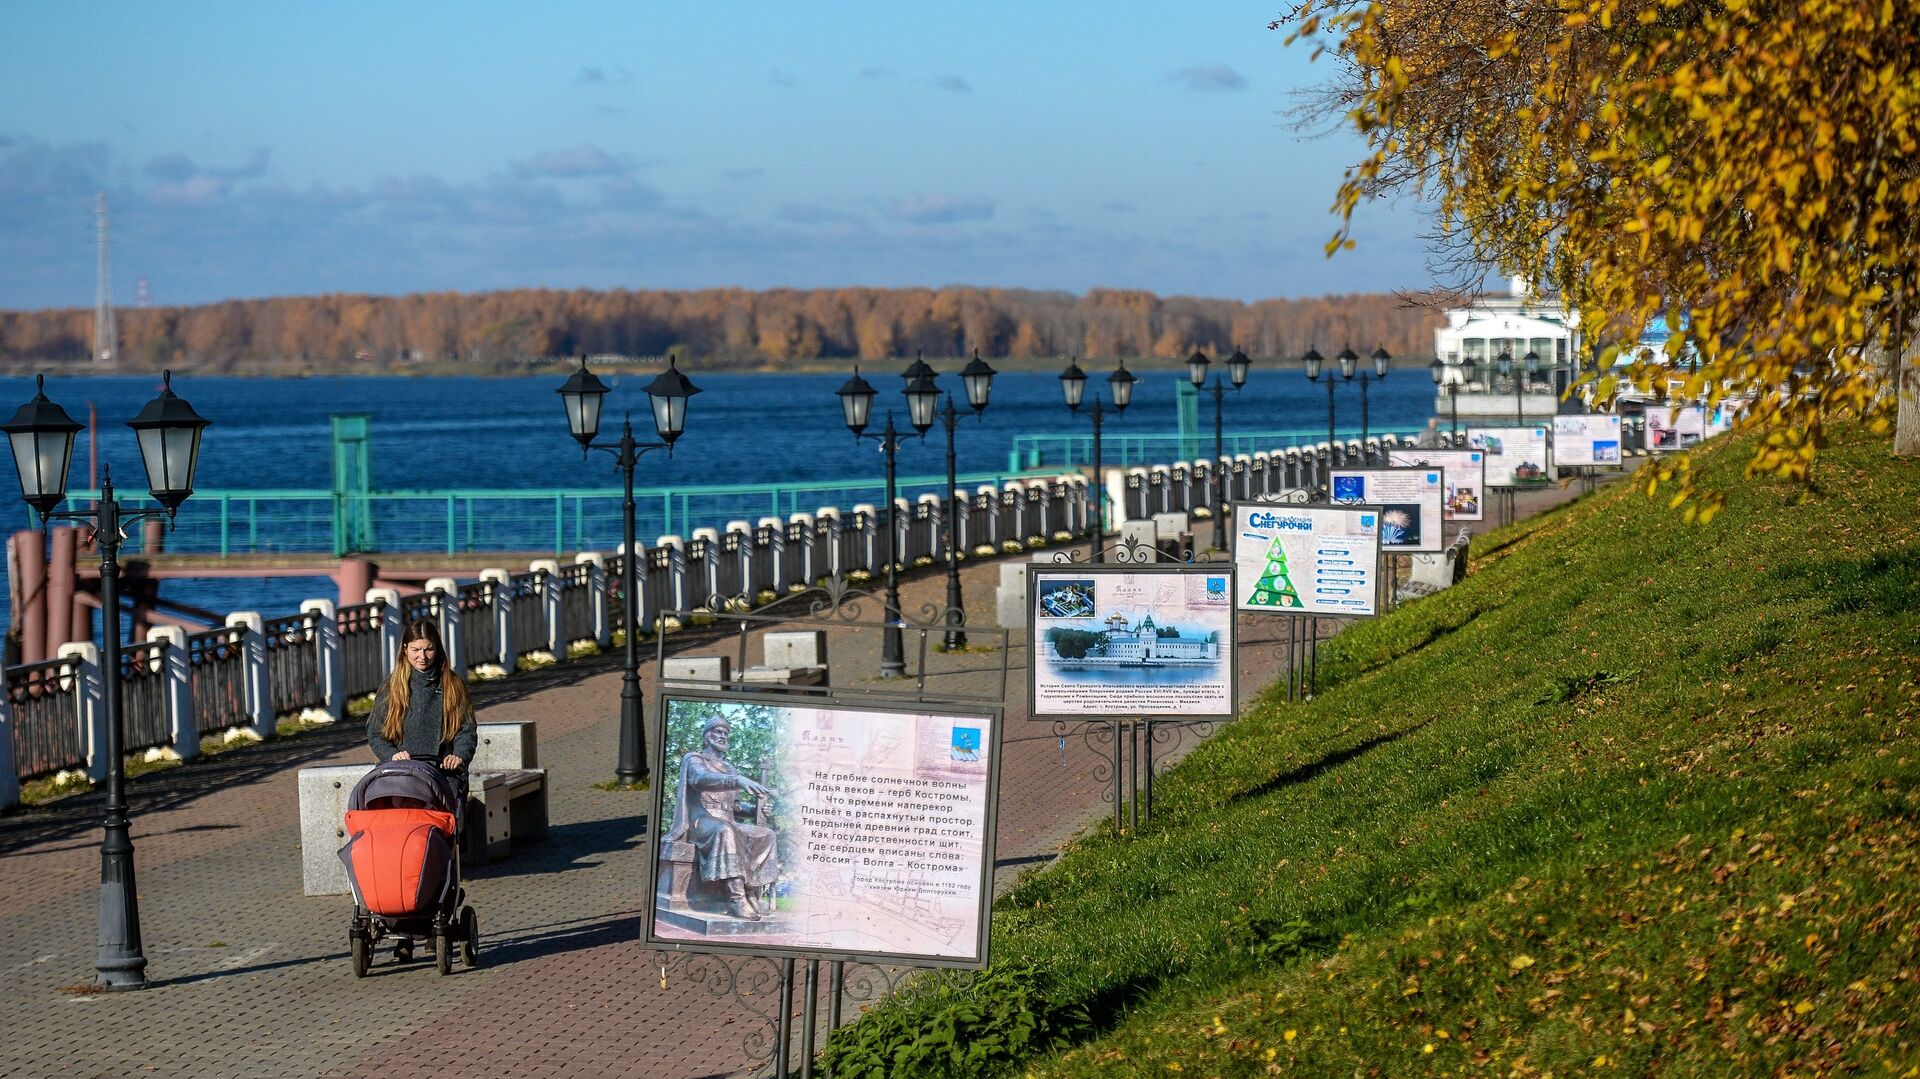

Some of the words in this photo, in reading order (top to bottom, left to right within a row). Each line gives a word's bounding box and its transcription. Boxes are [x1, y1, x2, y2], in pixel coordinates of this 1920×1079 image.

[815, 771, 828, 780] На
[832, 773, 867, 783] гребне
[871, 776, 928, 787] солнечной
[932, 781, 967, 790] волны
[808, 782, 841, 794] Ладья
[844, 786, 875, 795] веков
[888, 788, 911, 798] герб
[826, 796, 844, 805] Что
[848, 798, 893, 808] времени
[897, 801, 953, 813] наперекор
[801, 806, 842, 817] Плывёт
[855, 810, 925, 823] распахнутый
[802, 818, 862, 830] Твердыней
[864, 822, 910, 833] древний
[913, 826, 938, 836] град
[811, 830, 829, 839] Как
[832, 833, 935, 847] государственности
[808, 842, 826, 852] Где
[830, 845, 875, 856] сердцем
[878, 848, 925, 858] вписаны
[929, 852, 964, 861] слова:
[806, 854, 850, 865] «Россия
[863, 858, 894, 868] Волга
[907, 861, 964, 873] Кострома»
[918, 888, 957, 896] Долгоруким
